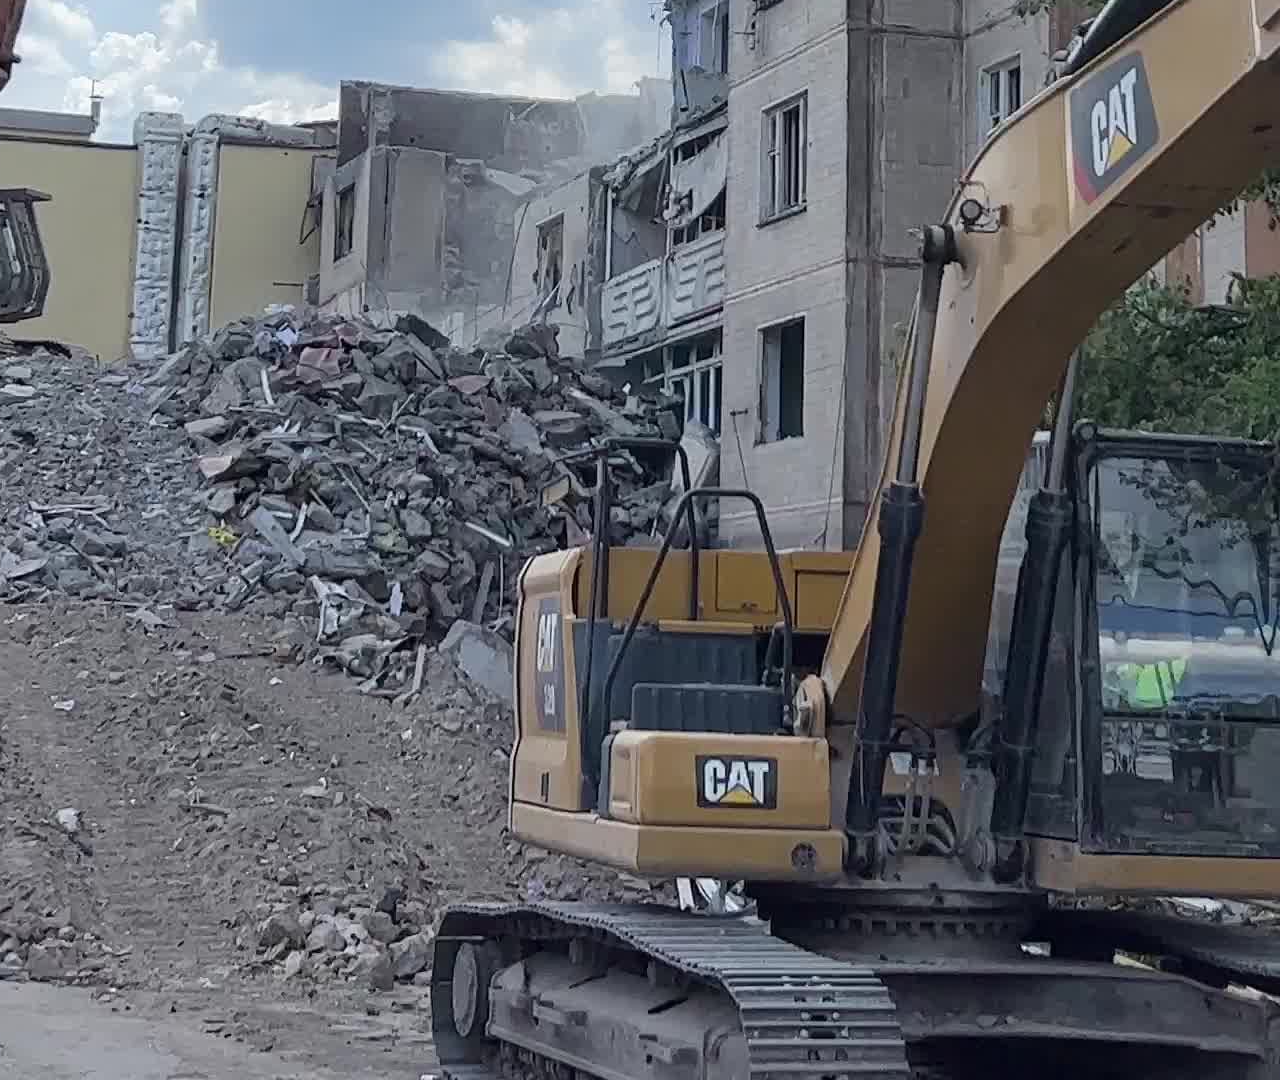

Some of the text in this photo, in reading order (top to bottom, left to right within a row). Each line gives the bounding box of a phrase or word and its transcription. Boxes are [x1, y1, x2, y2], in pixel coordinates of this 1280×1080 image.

[1091, 67, 1137, 177] CAT
[537, 613, 558, 672] CAT
[704, 759, 769, 804] CAT
